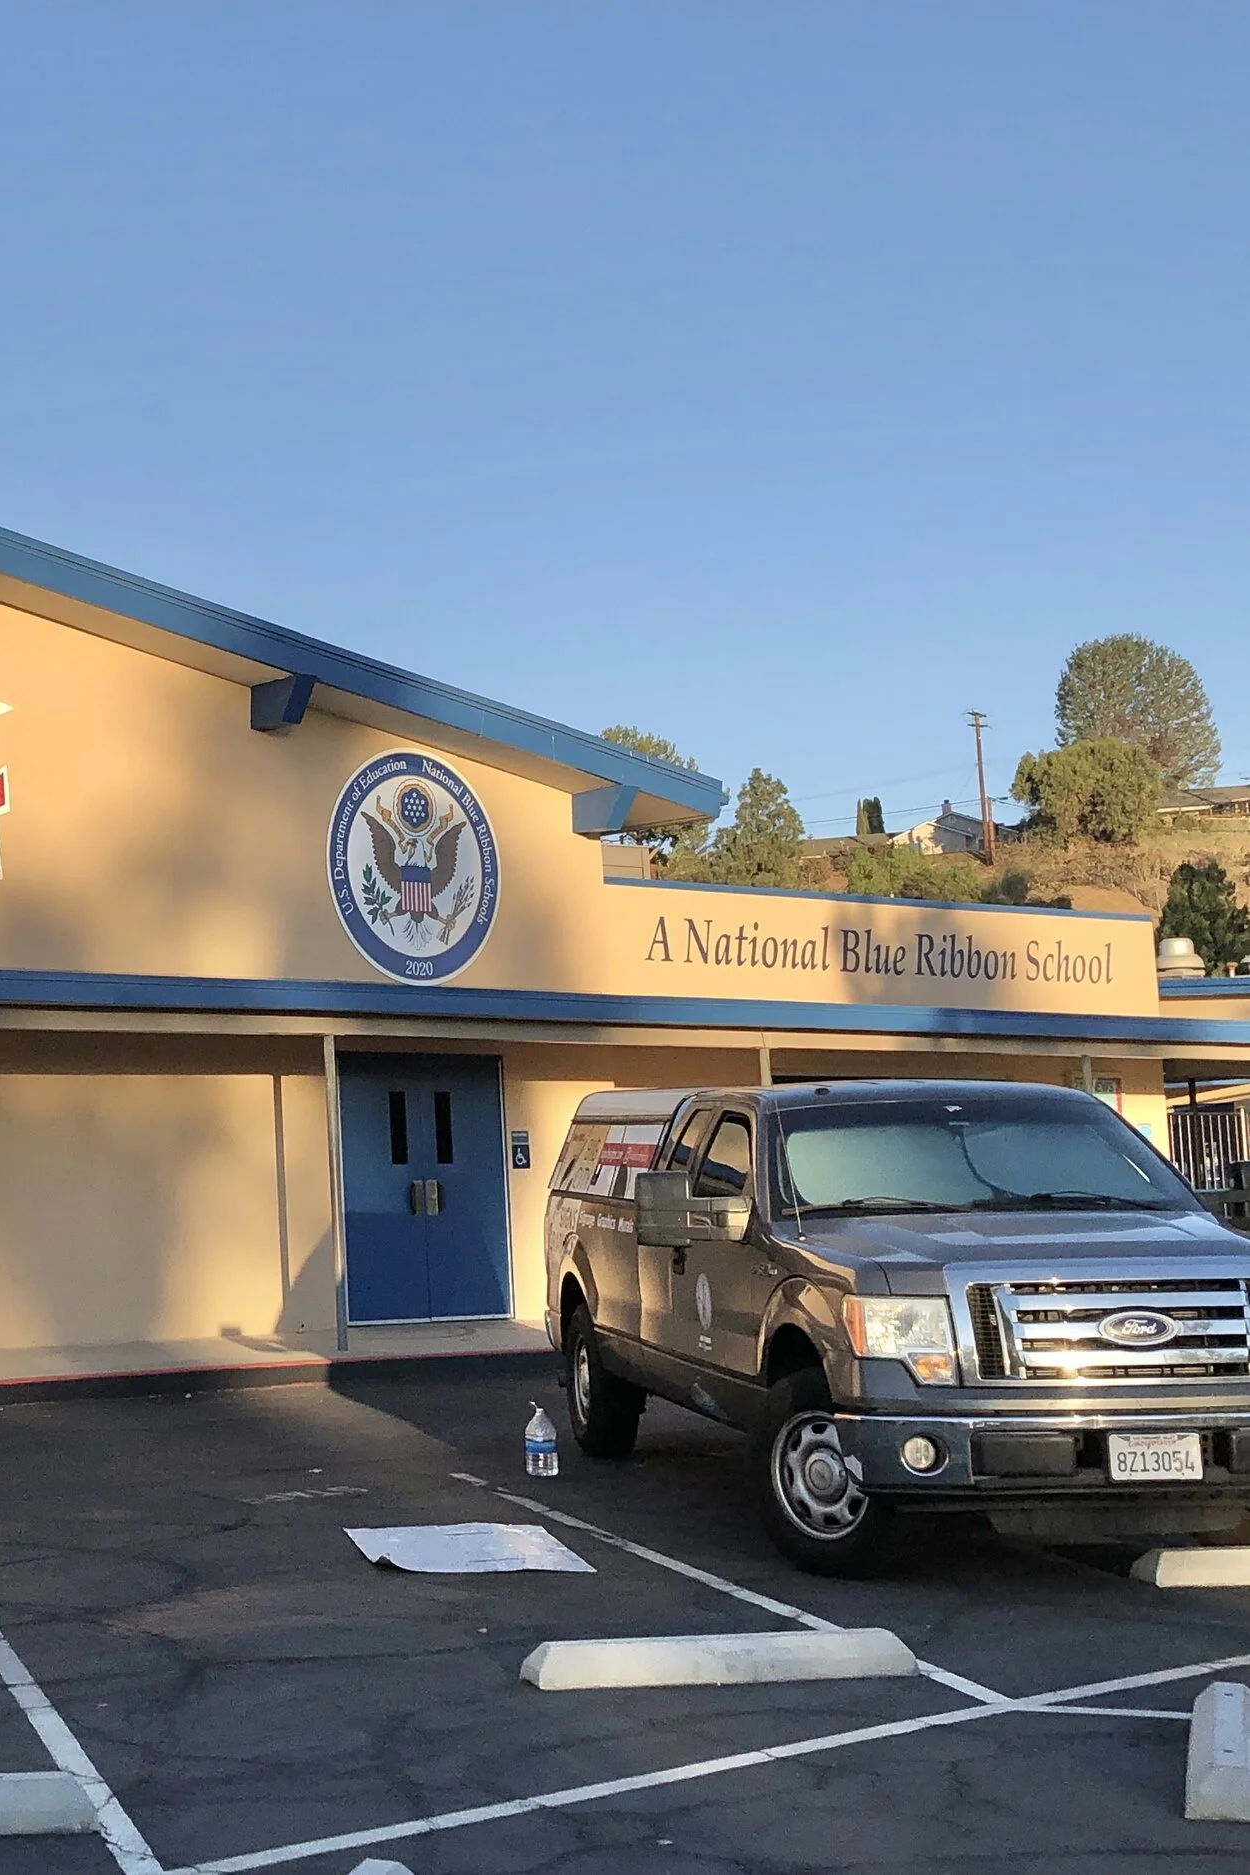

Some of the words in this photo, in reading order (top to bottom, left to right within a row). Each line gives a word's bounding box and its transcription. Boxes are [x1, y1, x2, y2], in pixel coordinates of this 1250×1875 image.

[351, 780, 364, 801] of
[359, 759, 407, 790] Education
[422, 759, 464, 797] National
[461, 791, 480, 823] Blue
[333, 801, 354, 881] Department
[476, 822, 493, 873] Ribbon
[338, 884, 354, 916] U.S.
[476, 877, 495, 926] Schools
[644, 915, 674, 963] A
[684, 918, 832, 972] National
[839, 928, 906, 977] Blue
[914, 933, 1018, 981] Ribbon
[1025, 939, 1114, 985] School
[405, 960, 434, 976] 2020
[1121, 1318, 1158, 1336] Ford
[1117, 1450, 1196, 1473] 8Z13054
